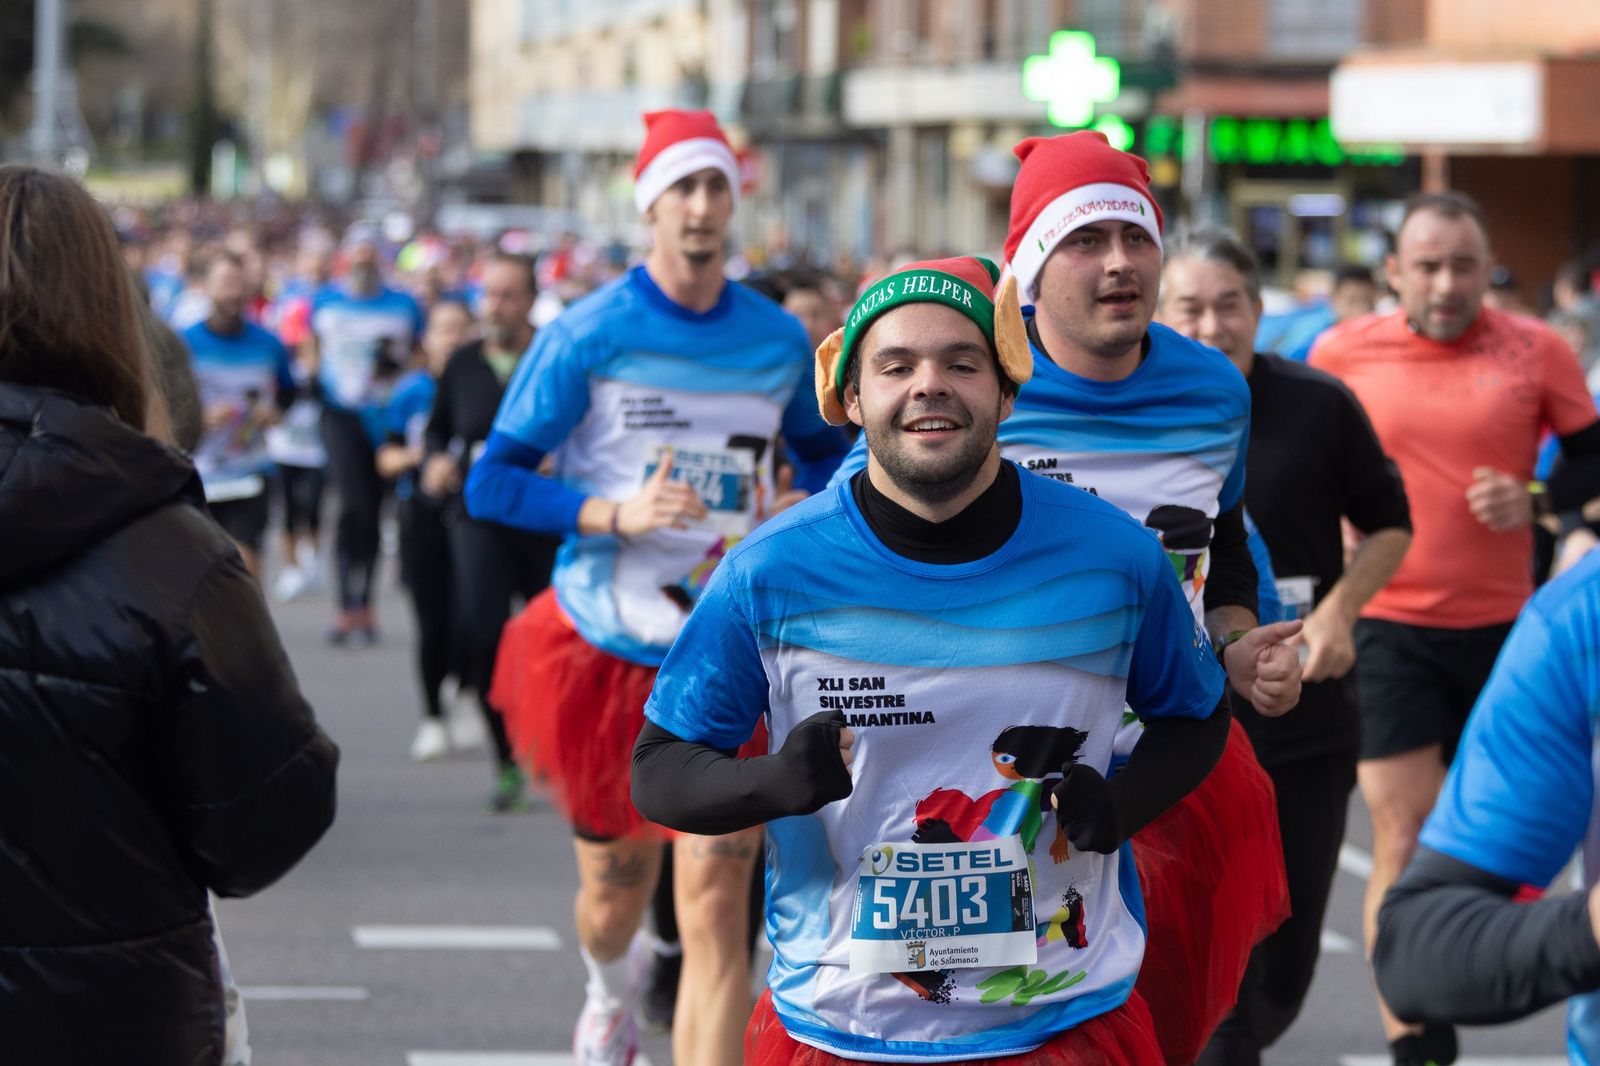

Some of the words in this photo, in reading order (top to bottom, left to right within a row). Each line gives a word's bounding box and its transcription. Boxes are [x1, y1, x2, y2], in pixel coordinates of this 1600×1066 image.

[1076, 200, 1139, 216] NAVIDAD
[851, 281, 895, 328] SANTAS
[902, 276, 973, 309] HELPER
[1027, 458, 1058, 470] SAN
[817, 678, 844, 691] XLI
[849, 677, 885, 691] SAN
[819, 694, 906, 709] SILVESTRE
[845, 711, 936, 727] LMANTINA
[896, 848, 1013, 872] SETEL
[873, 875, 988, 930] 5403
[929, 946, 979, 957] Ayuntamiento
[930, 958, 939, 966] de
[940, 957, 979, 965] Salamanca
